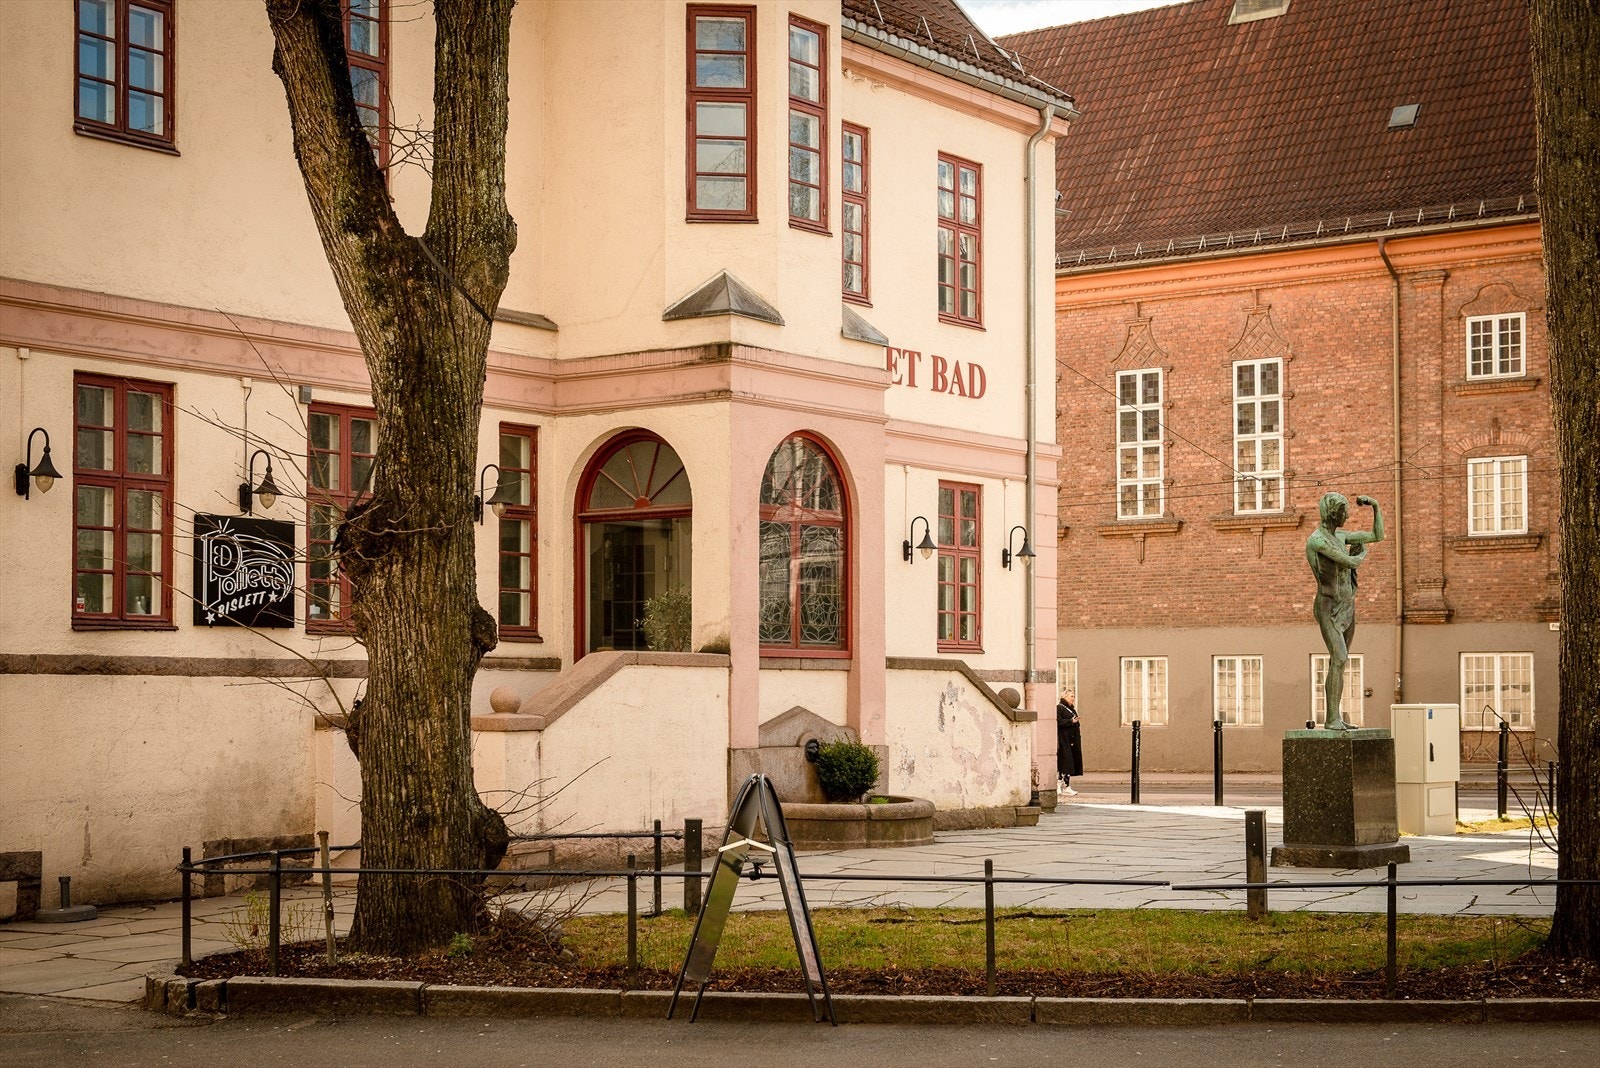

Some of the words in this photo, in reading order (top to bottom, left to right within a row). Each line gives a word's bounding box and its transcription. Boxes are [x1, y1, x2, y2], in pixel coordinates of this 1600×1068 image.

[886, 346, 921, 388] ET
[930, 354, 986, 400] BAD
[217, 591, 267, 618] BISLETT
